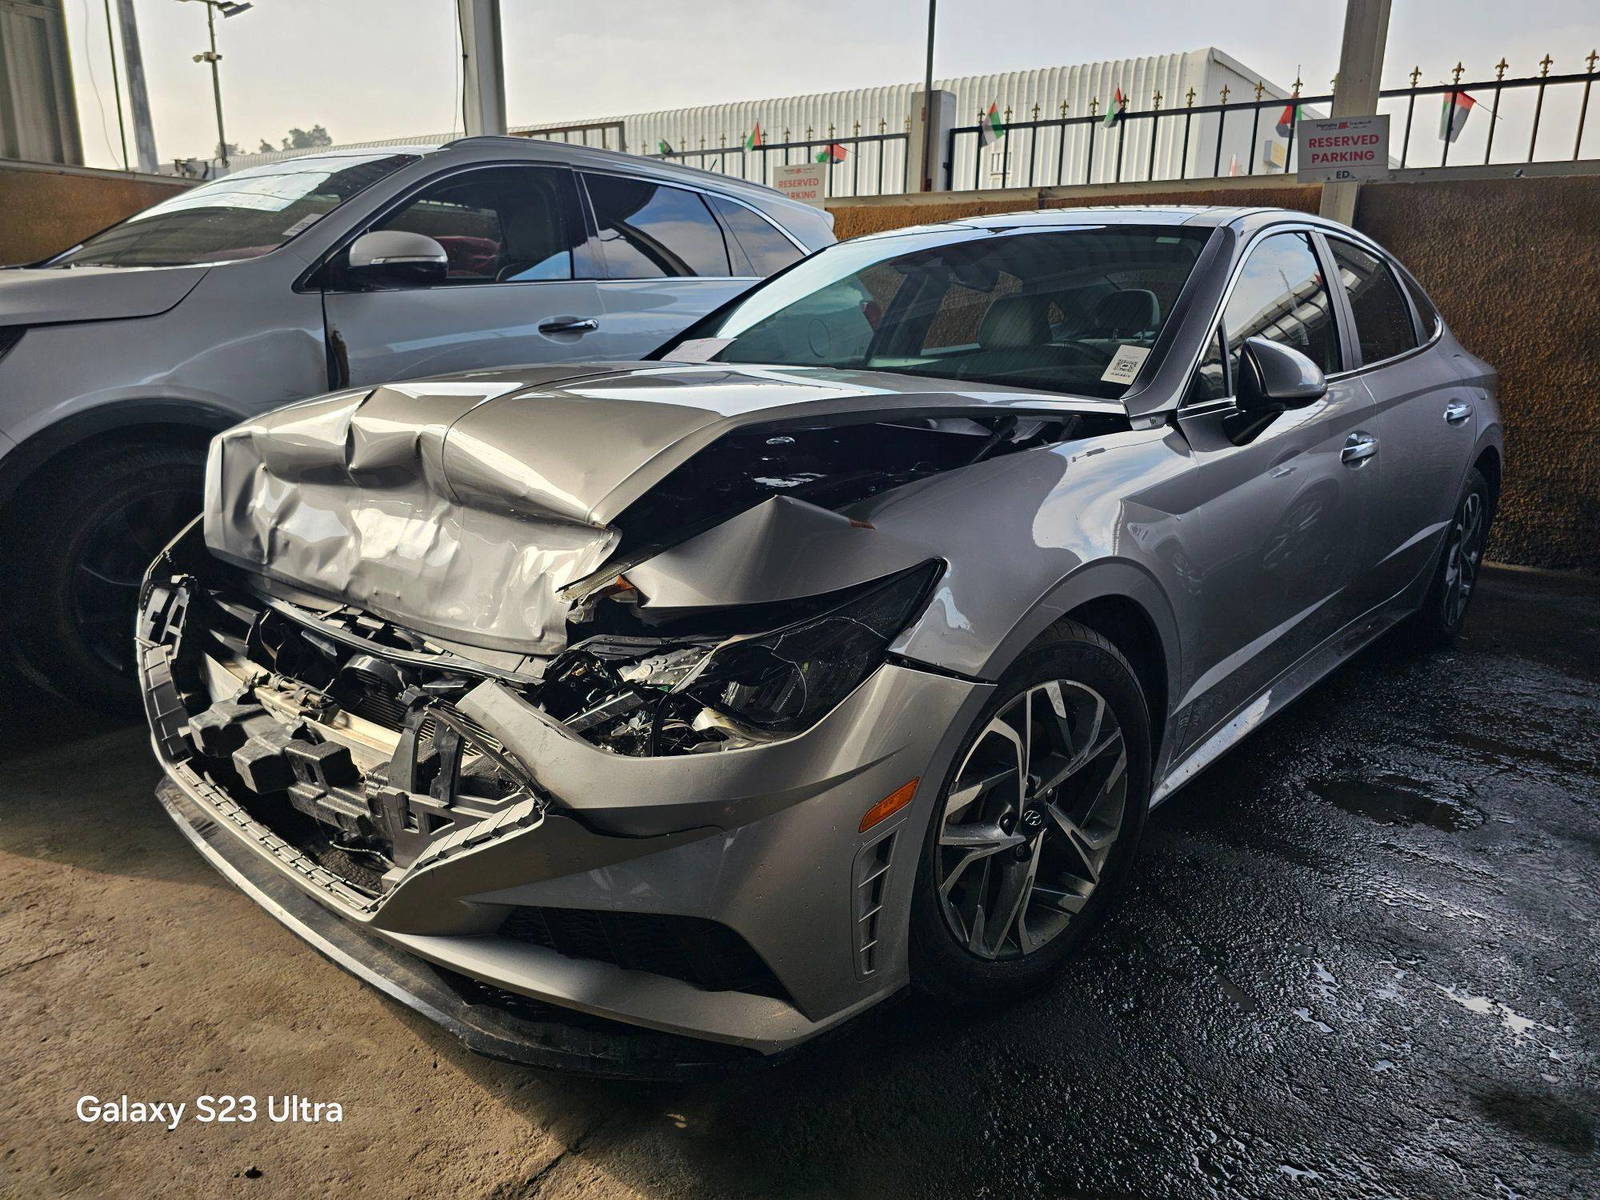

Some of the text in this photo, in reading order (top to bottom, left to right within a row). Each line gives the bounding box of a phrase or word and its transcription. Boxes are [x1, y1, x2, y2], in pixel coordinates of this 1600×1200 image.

[1308, 134, 1380, 148] RESERVED
[1312, 150, 1375, 163] PARKING
[778, 178, 819, 188] RESERVED
